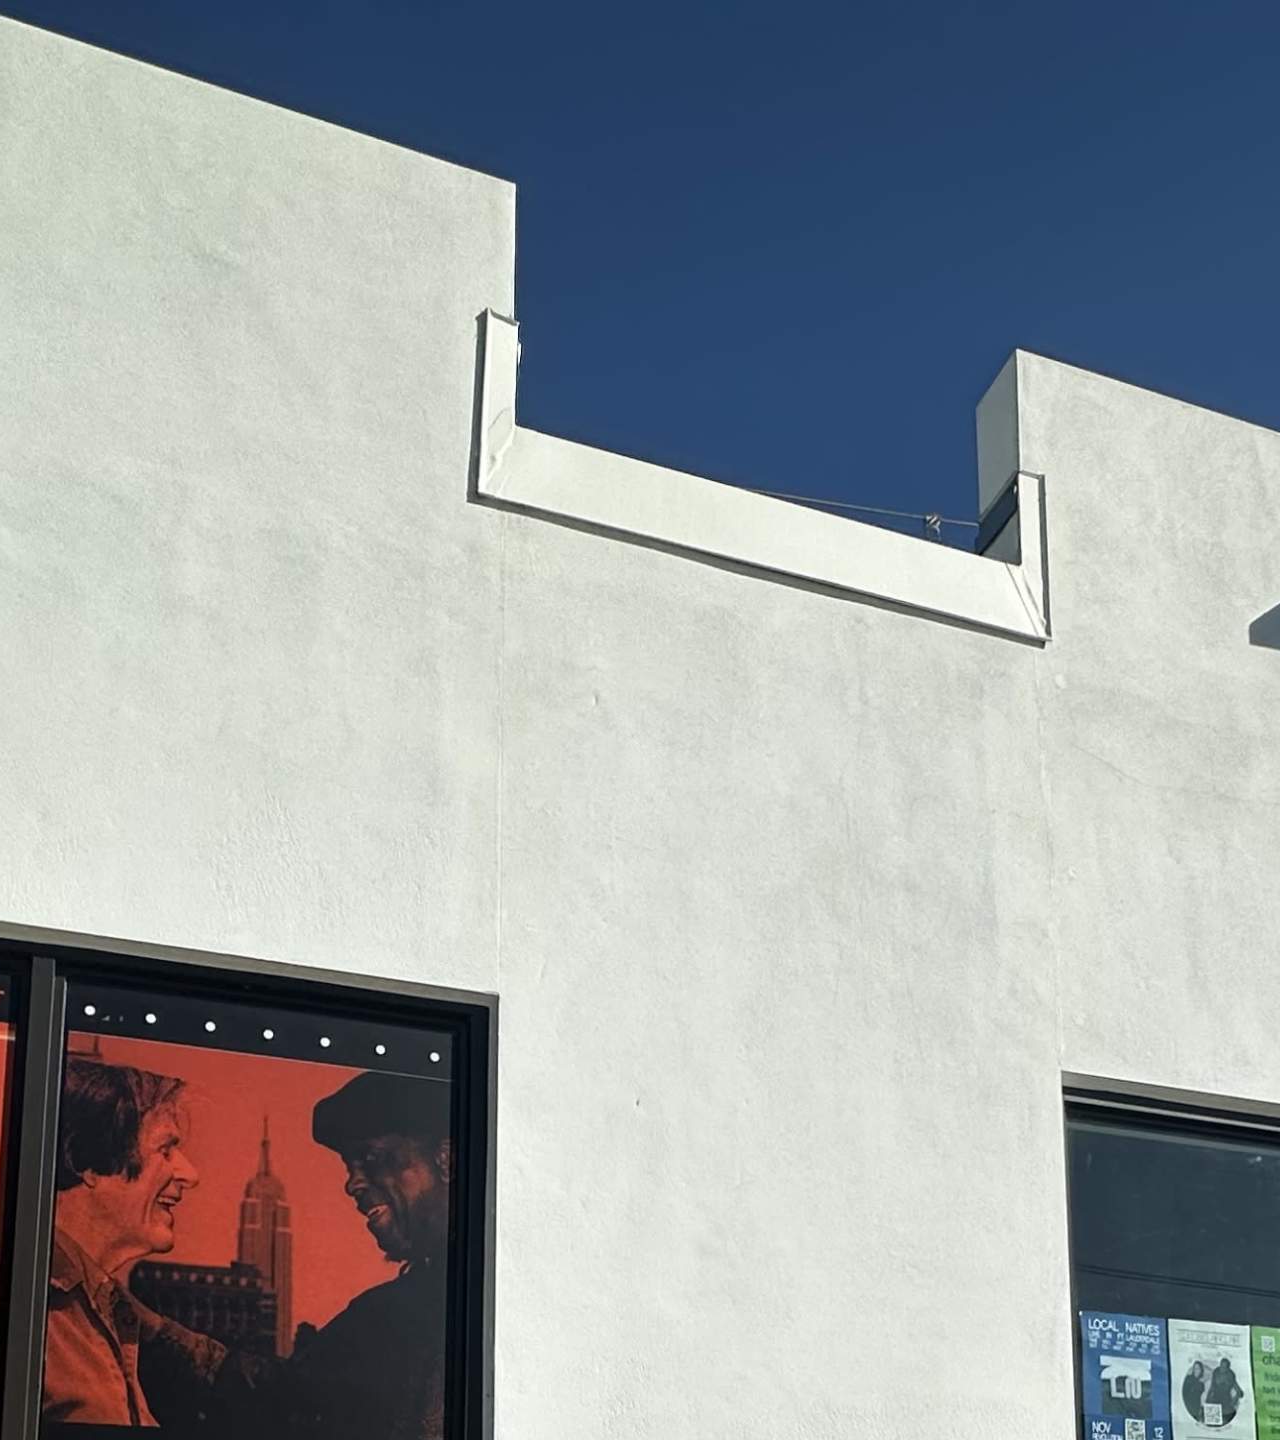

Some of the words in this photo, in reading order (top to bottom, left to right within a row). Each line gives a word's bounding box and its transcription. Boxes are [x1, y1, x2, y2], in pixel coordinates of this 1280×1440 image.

[1088, 1318, 1119, 1332] LOCAL
[1125, 1321, 1160, 1336] NATIVES
[1092, 1421, 1111, 1433] NOV
